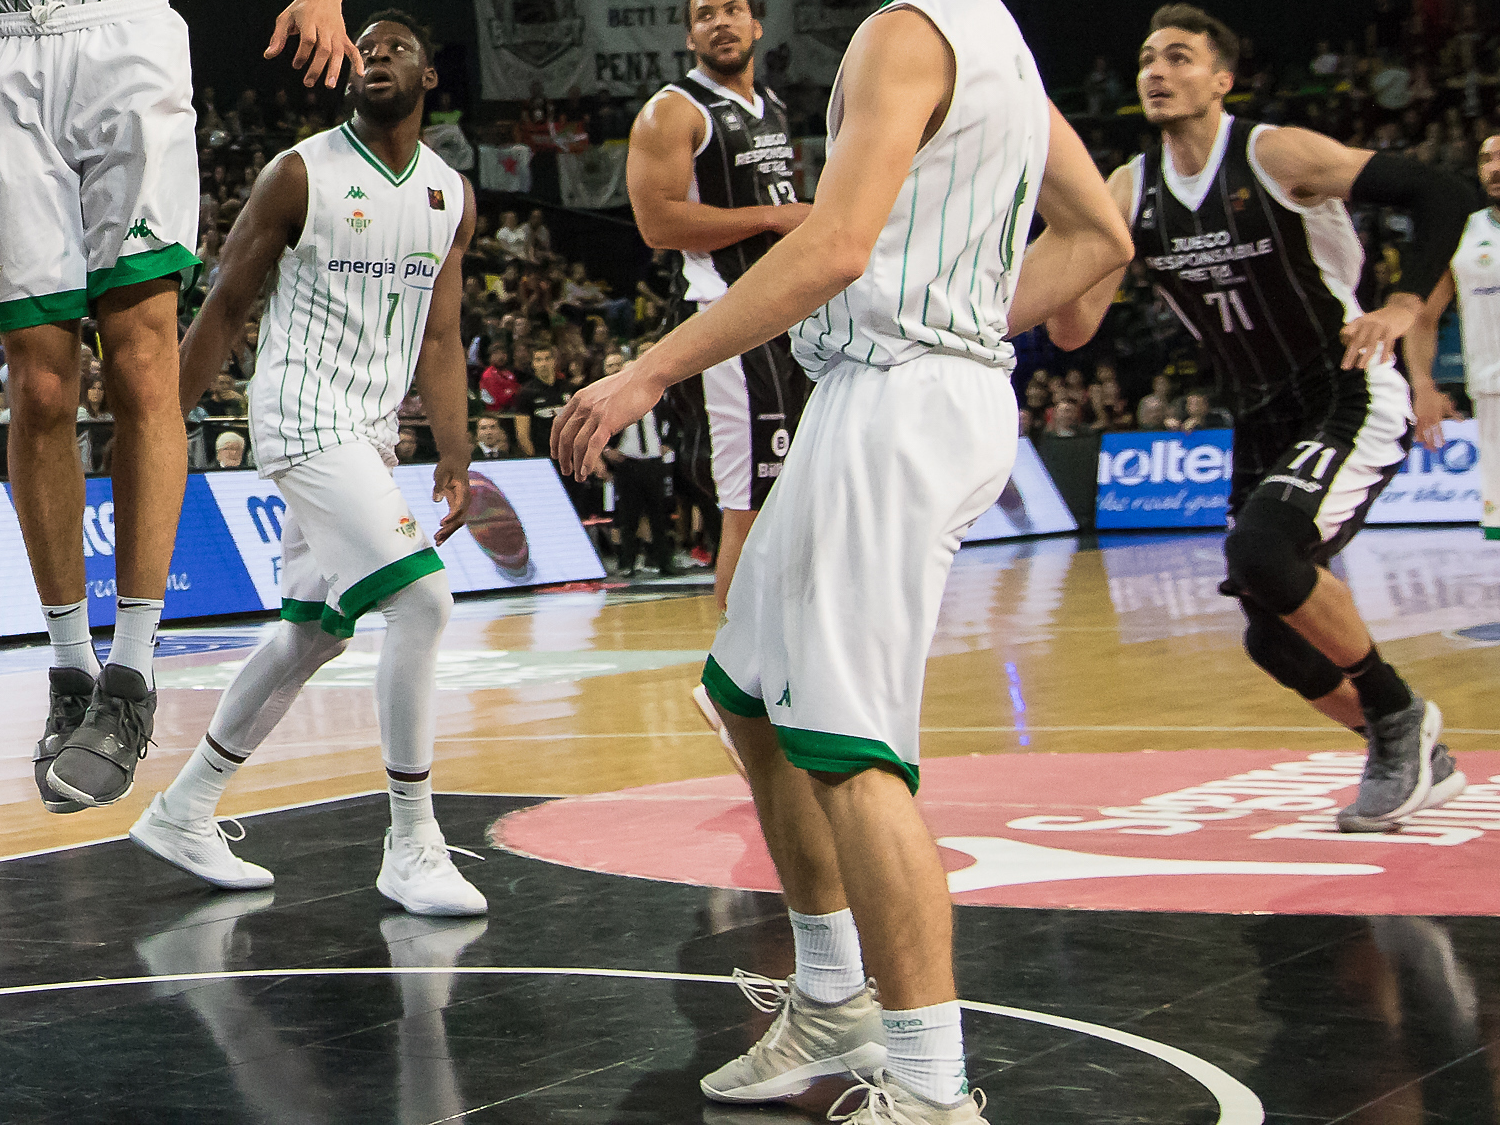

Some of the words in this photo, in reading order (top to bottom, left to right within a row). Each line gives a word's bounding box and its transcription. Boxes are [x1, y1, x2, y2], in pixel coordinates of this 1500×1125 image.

[327, 258, 396, 278] energía
[404, 261, 435, 279] plu
[383, 292, 400, 339] 7
[1202, 288, 1255, 333] 71
[1097, 438, 1230, 486] olte
[1287, 440, 1337, 480] 71
